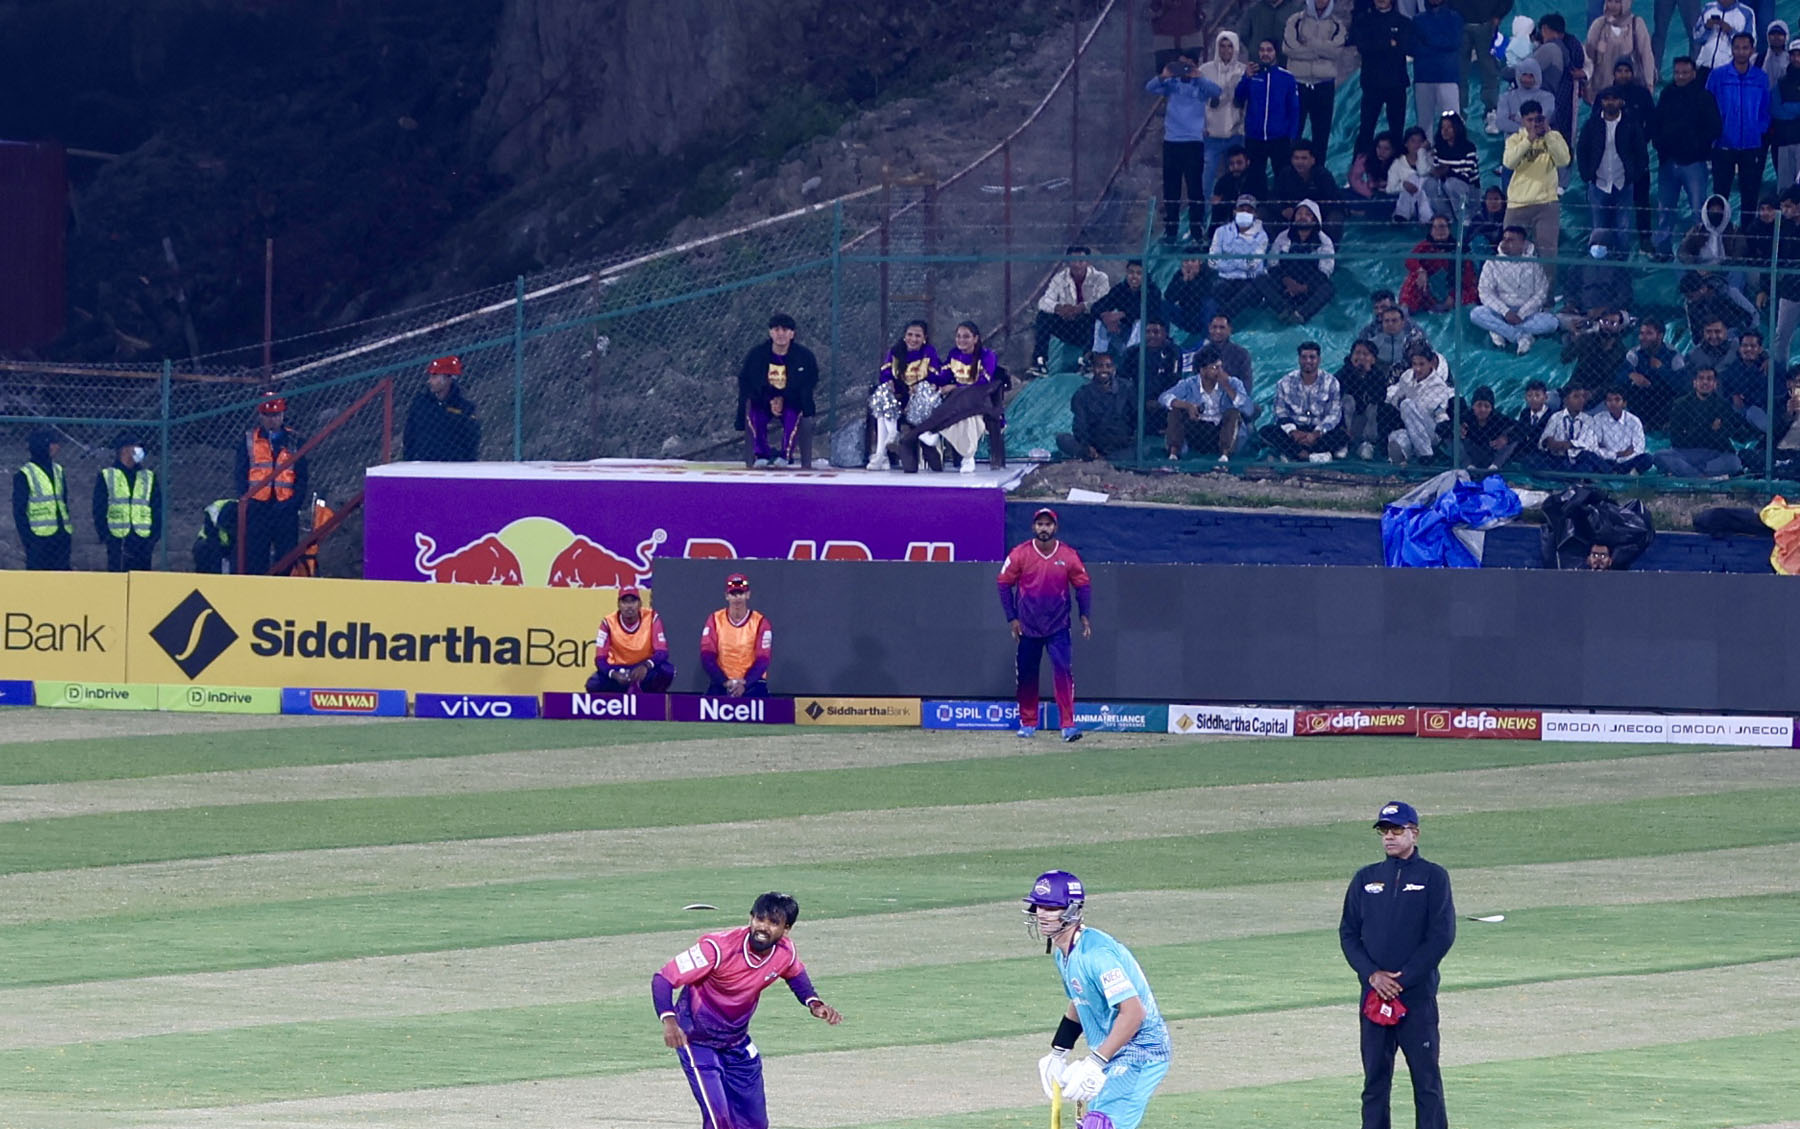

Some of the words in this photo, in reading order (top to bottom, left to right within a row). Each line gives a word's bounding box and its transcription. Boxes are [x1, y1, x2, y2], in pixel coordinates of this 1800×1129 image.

[84, 687, 130, 700] inDrive
[207, 691, 252, 704] inDrive
[313, 694, 343, 707] WAI
[345, 695, 374, 708] WAI
[440, 696, 512, 718] vivo
[571, 693, 637, 716] Ncell
[700, 698, 764, 721] Ncell
[955, 707, 982, 719] SPIL
[1106, 714, 1146, 723] RELIANCE
[1196, 713, 1251, 732] Siddhartha
[1252, 716, 1288, 735] Capital
[1546, 721, 1600, 732] OMODA
[1609, 724, 1663, 734] JAECOO
[1671, 724, 1725, 735] OMODA
[1735, 726, 1788, 736] JAECOO
